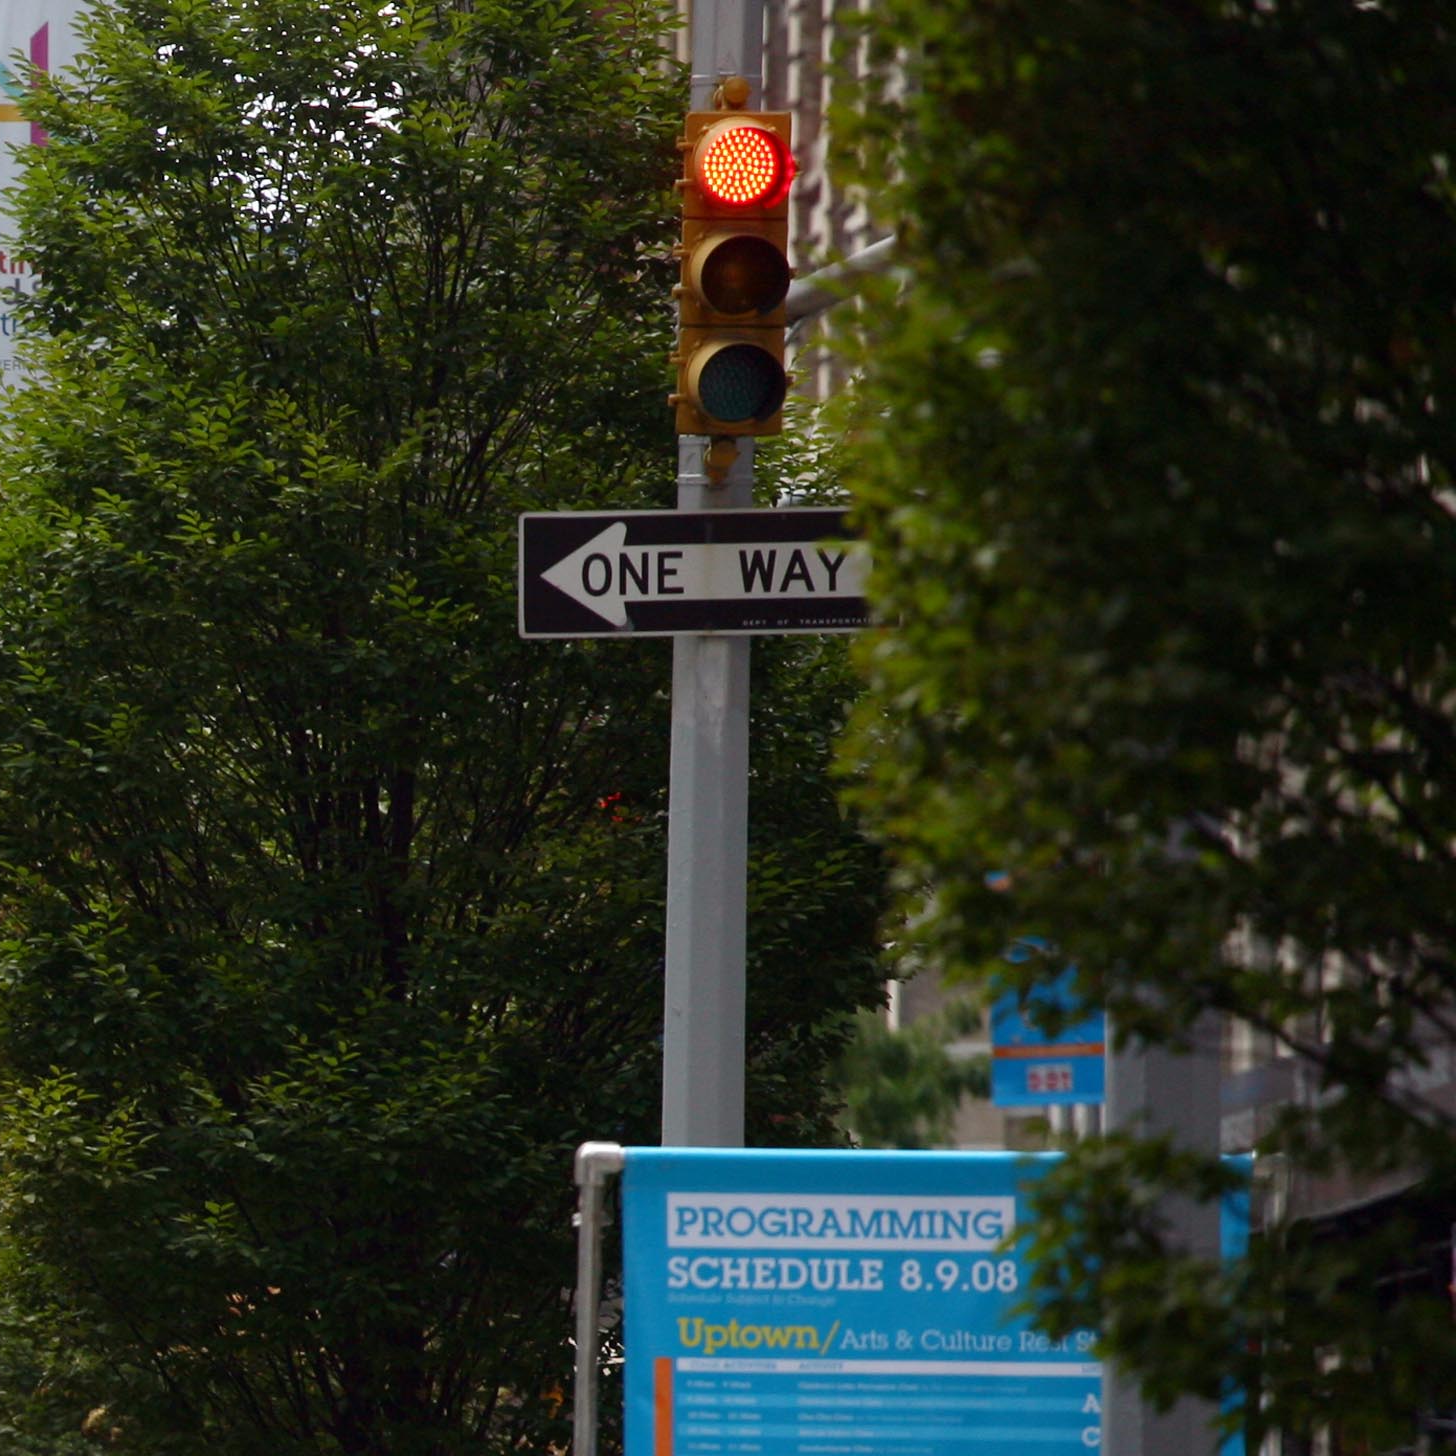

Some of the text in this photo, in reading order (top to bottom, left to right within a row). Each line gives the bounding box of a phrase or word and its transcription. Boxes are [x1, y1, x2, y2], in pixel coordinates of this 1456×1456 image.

[582, 548, 848, 596] ONE WAY
[799, 617, 876, 625] TRANSPORTATI
[675, 1207, 1003, 1240] PROGRAMMING
[667, 1256, 1019, 1292] SCHEDULE 8.9.08
[896, 1330, 913, 1351] &
[921, 1329, 1012, 1352] Culture
